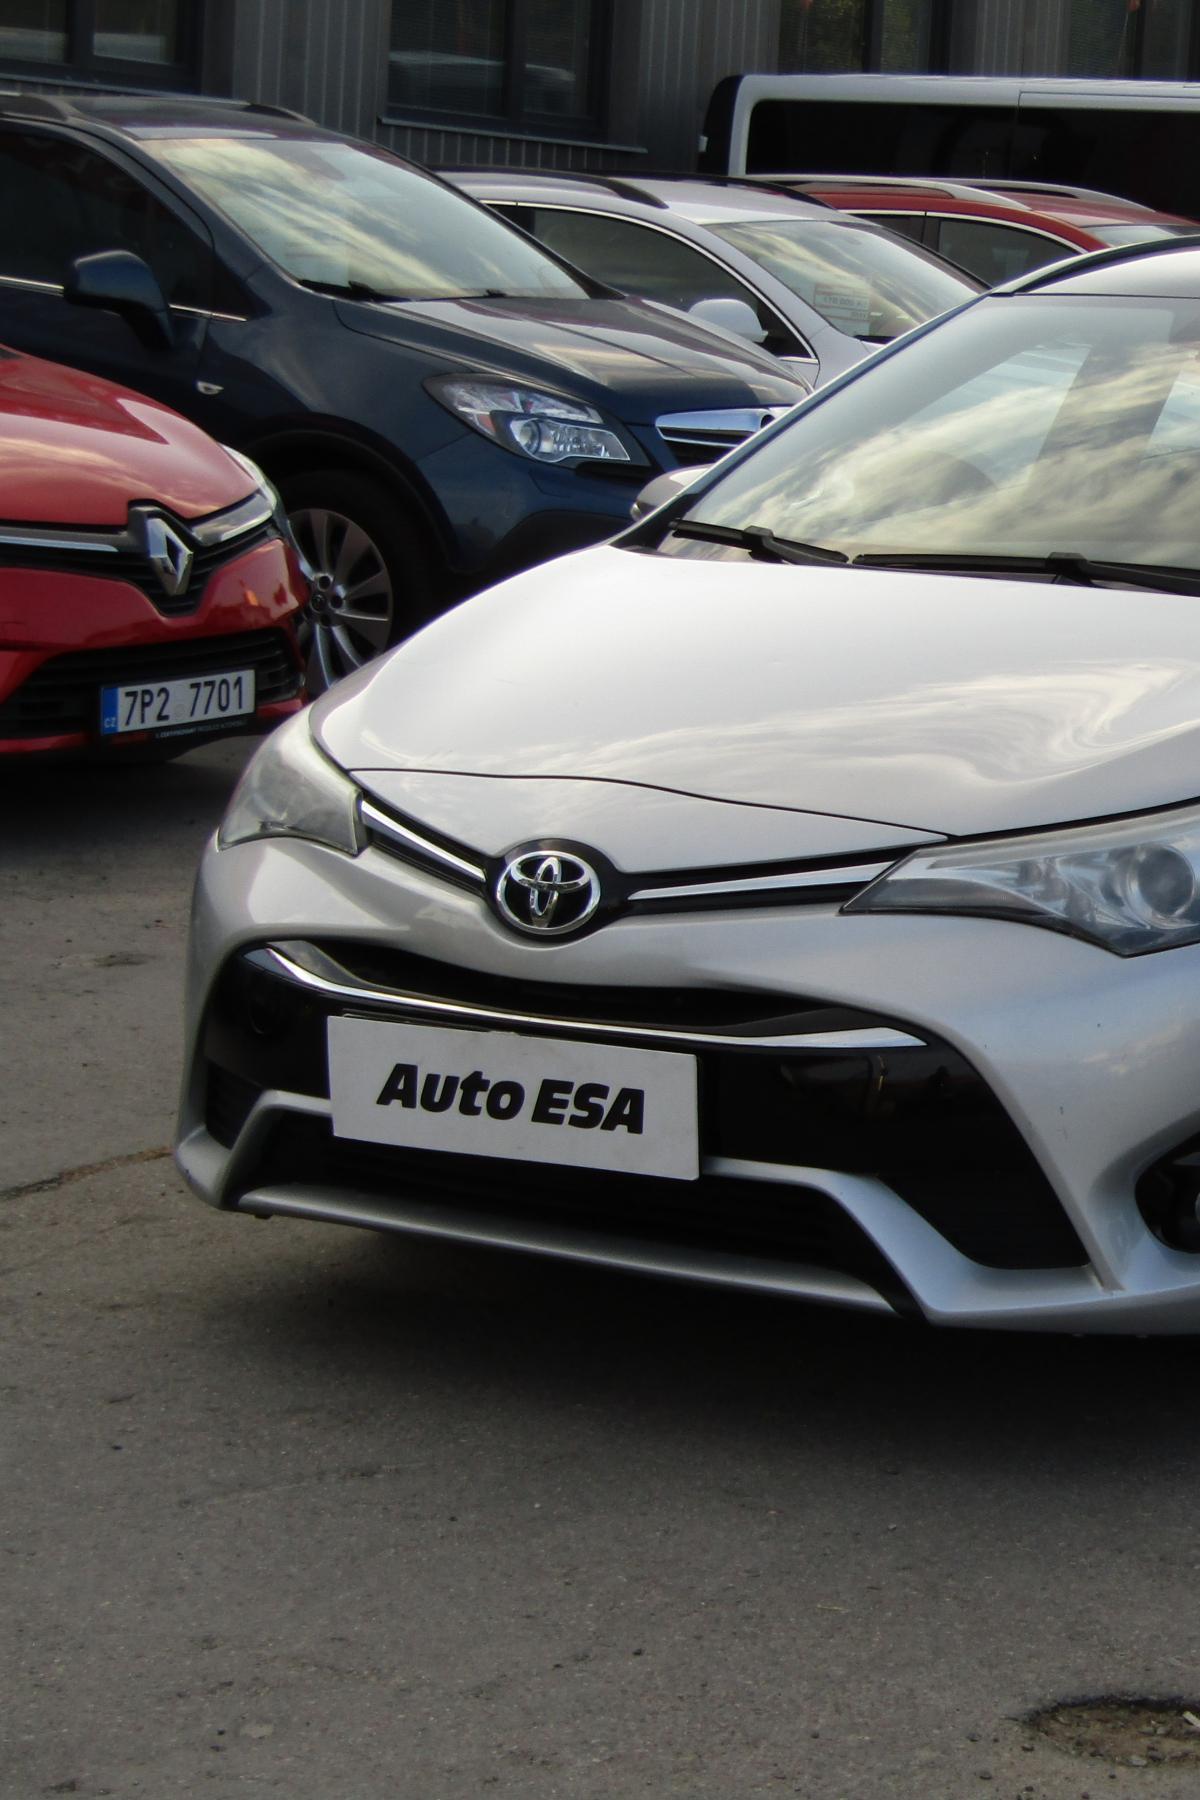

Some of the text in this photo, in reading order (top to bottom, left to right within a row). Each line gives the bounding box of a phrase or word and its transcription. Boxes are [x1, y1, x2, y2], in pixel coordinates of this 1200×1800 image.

[104, 717, 117, 728] CZ
[124, 676, 243, 726] 7P2 7701
[376, 1063, 645, 1135] Auto ESA
